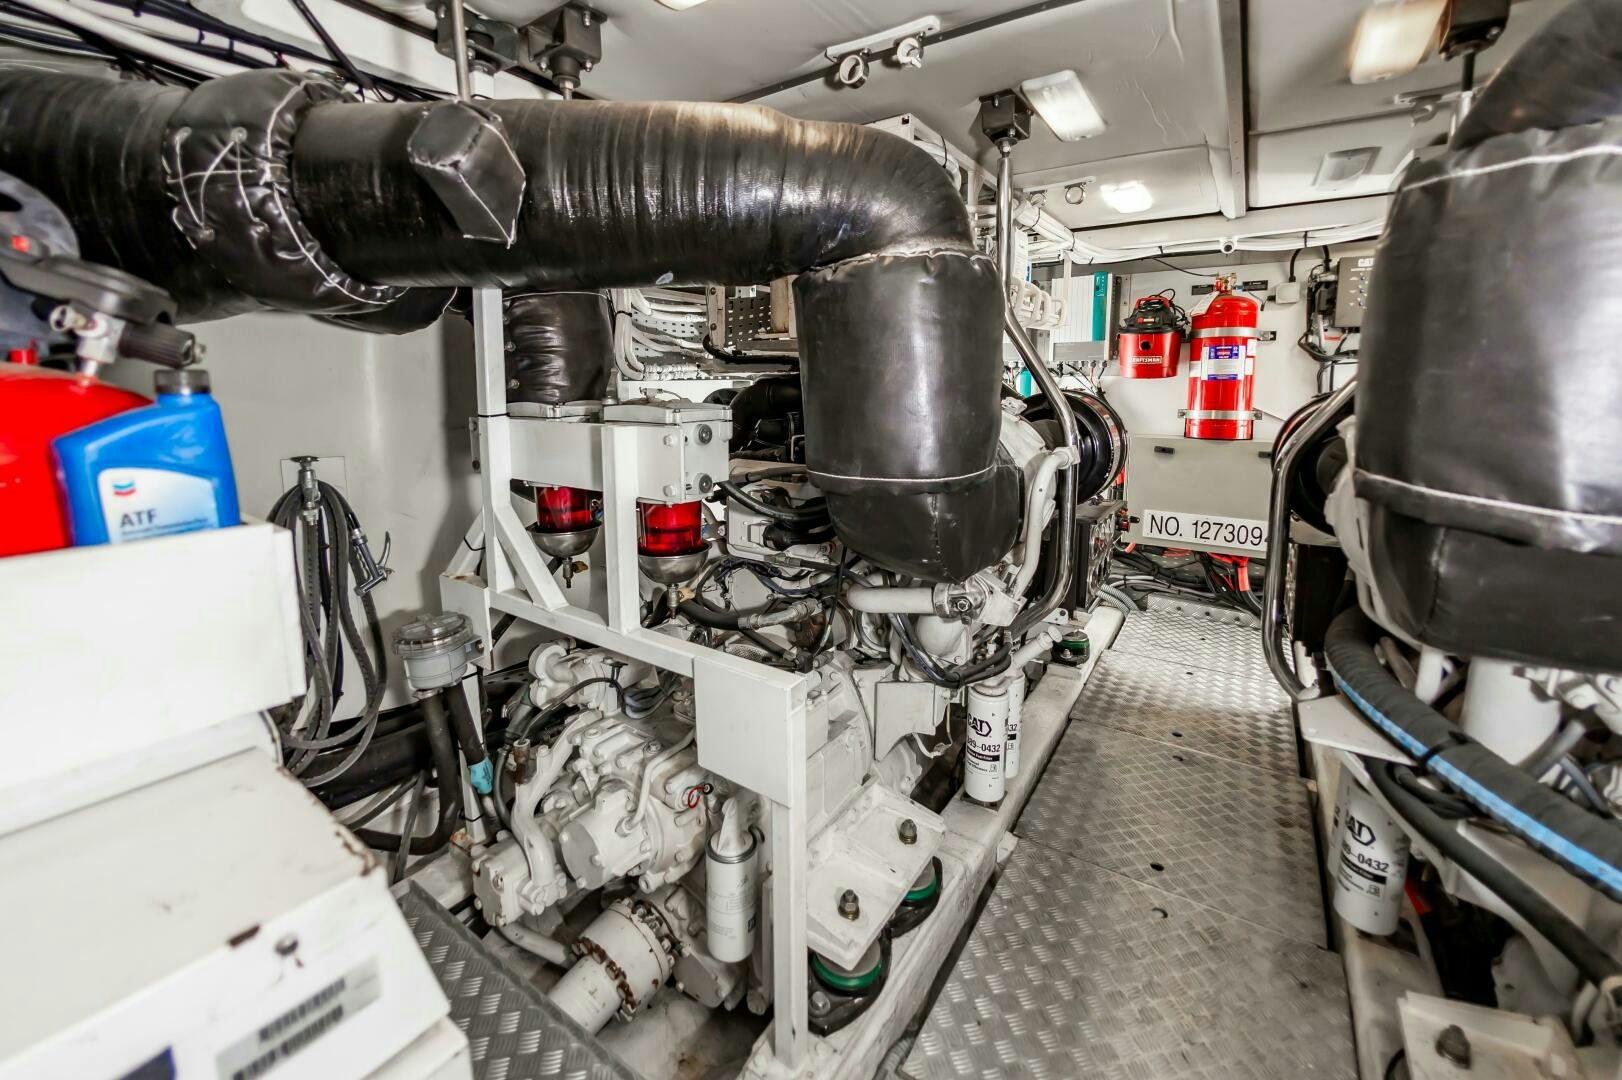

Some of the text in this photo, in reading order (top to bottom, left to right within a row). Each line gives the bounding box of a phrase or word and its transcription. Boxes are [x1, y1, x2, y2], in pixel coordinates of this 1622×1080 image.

[120, 508, 156, 527] ATF
[1150, 514, 1270, 546] NO. 127309
